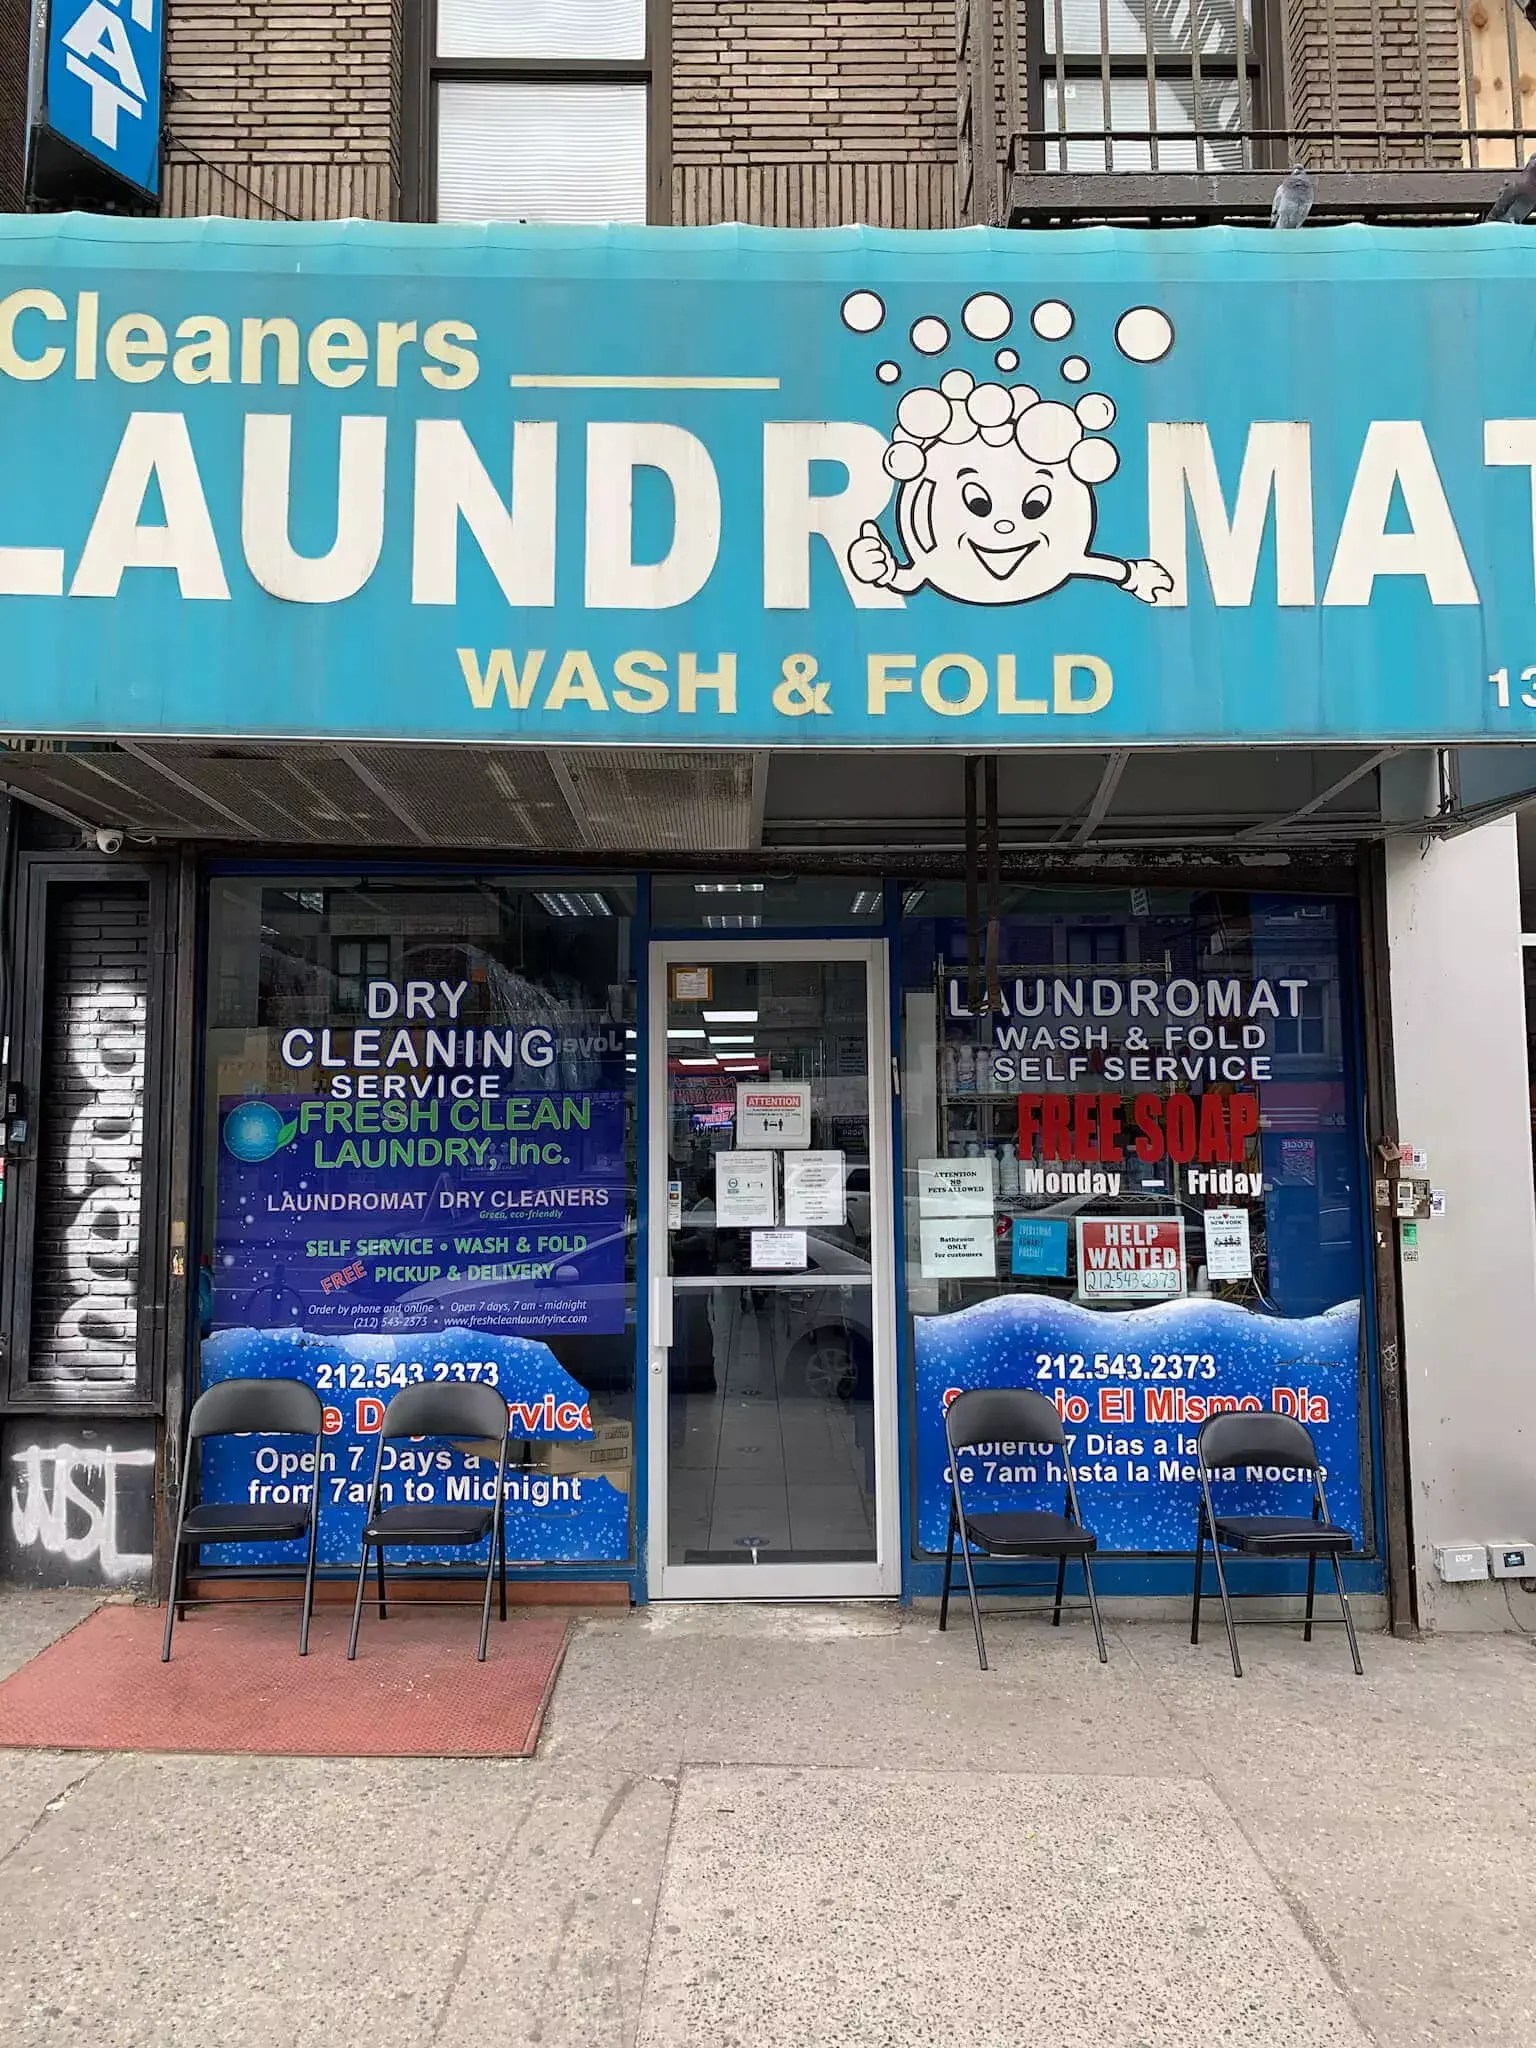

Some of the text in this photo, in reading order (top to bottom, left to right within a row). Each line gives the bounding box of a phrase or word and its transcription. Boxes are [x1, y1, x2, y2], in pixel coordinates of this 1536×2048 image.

[61, 0, 152, 150] AT
[0, 289, 480, 390] Cleaners
[457, 648, 1113, 716] WASH & FOLD
[368, 981, 467, 1019] DRY
[282, 1029, 554, 1068] CLEANING
[996, 1025, 1267, 1050] WASH & FOLD
[994, 1056, 1272, 1081] SELF SERVICE
[330, 1075, 500, 1099] SERVICE
[748, 1098, 800, 1106] ATTENTION
[300, 1097, 591, 1134] FRESH CLEAN
[1017, 1093, 1259, 1163] FREE SOAP
[315, 1137, 571, 1171] LAUNDRY, Inc.
[1025, 1169, 1121, 1196] Monday
[1188, 1169, 1263, 1197] Friday
[267, 1188, 609, 1212] LAUNDROMAT DRY CLEANERS
[479, 1210, 508, 1220] Green,
[306, 1235, 587, 1257] SELF SERVICE WASH & FOLD
[1105, 1224, 1159, 1246] HELP
[1087, 1247, 1177, 1270] WANTED
[320, 1260, 367, 1295] FREE
[375, 1263, 555, 1283] PICKUP & DELIVERY
[308, 1304, 335, 1315] Order
[338, 1304, 349, 1316] by
[351, 1304, 381, 1316] phone
[383, 1303, 401, 1314] and
[404, 1303, 434, 1314] online
[450, 1302, 476, 1313] Open
[479, 1302, 486, 1312] 7
[544, 1300, 587, 1312] midnight
[354, 1317, 378, 1328] (212)
[316, 1362, 499, 1388] 212.5432373
[1035, 1354, 1216, 1380] 212.543.2373
[1099, 1387, 1134, 1423] El
[1144, 1387, 1262, 1423] Mismo
[1272, 1387, 1329, 1423] Dia
[1087, 1433, 1144, 1456] Dias
[1153, 1438, 1168, 1456] a
[1178, 1433, 1198, 1455] la
[256, 1447, 336, 1479] Open
[348, 1446, 364, 1472] 7
[381, 1446, 452, 1477] Days
[463, 1453, 480, 1470] a
[983, 1462, 1037, 1483] 7am
[1046, 1461, 1118, 1483] hasta
[1127, 1461, 1149, 1482] la
[248, 1476, 582, 1505] from 7am to Midnight
